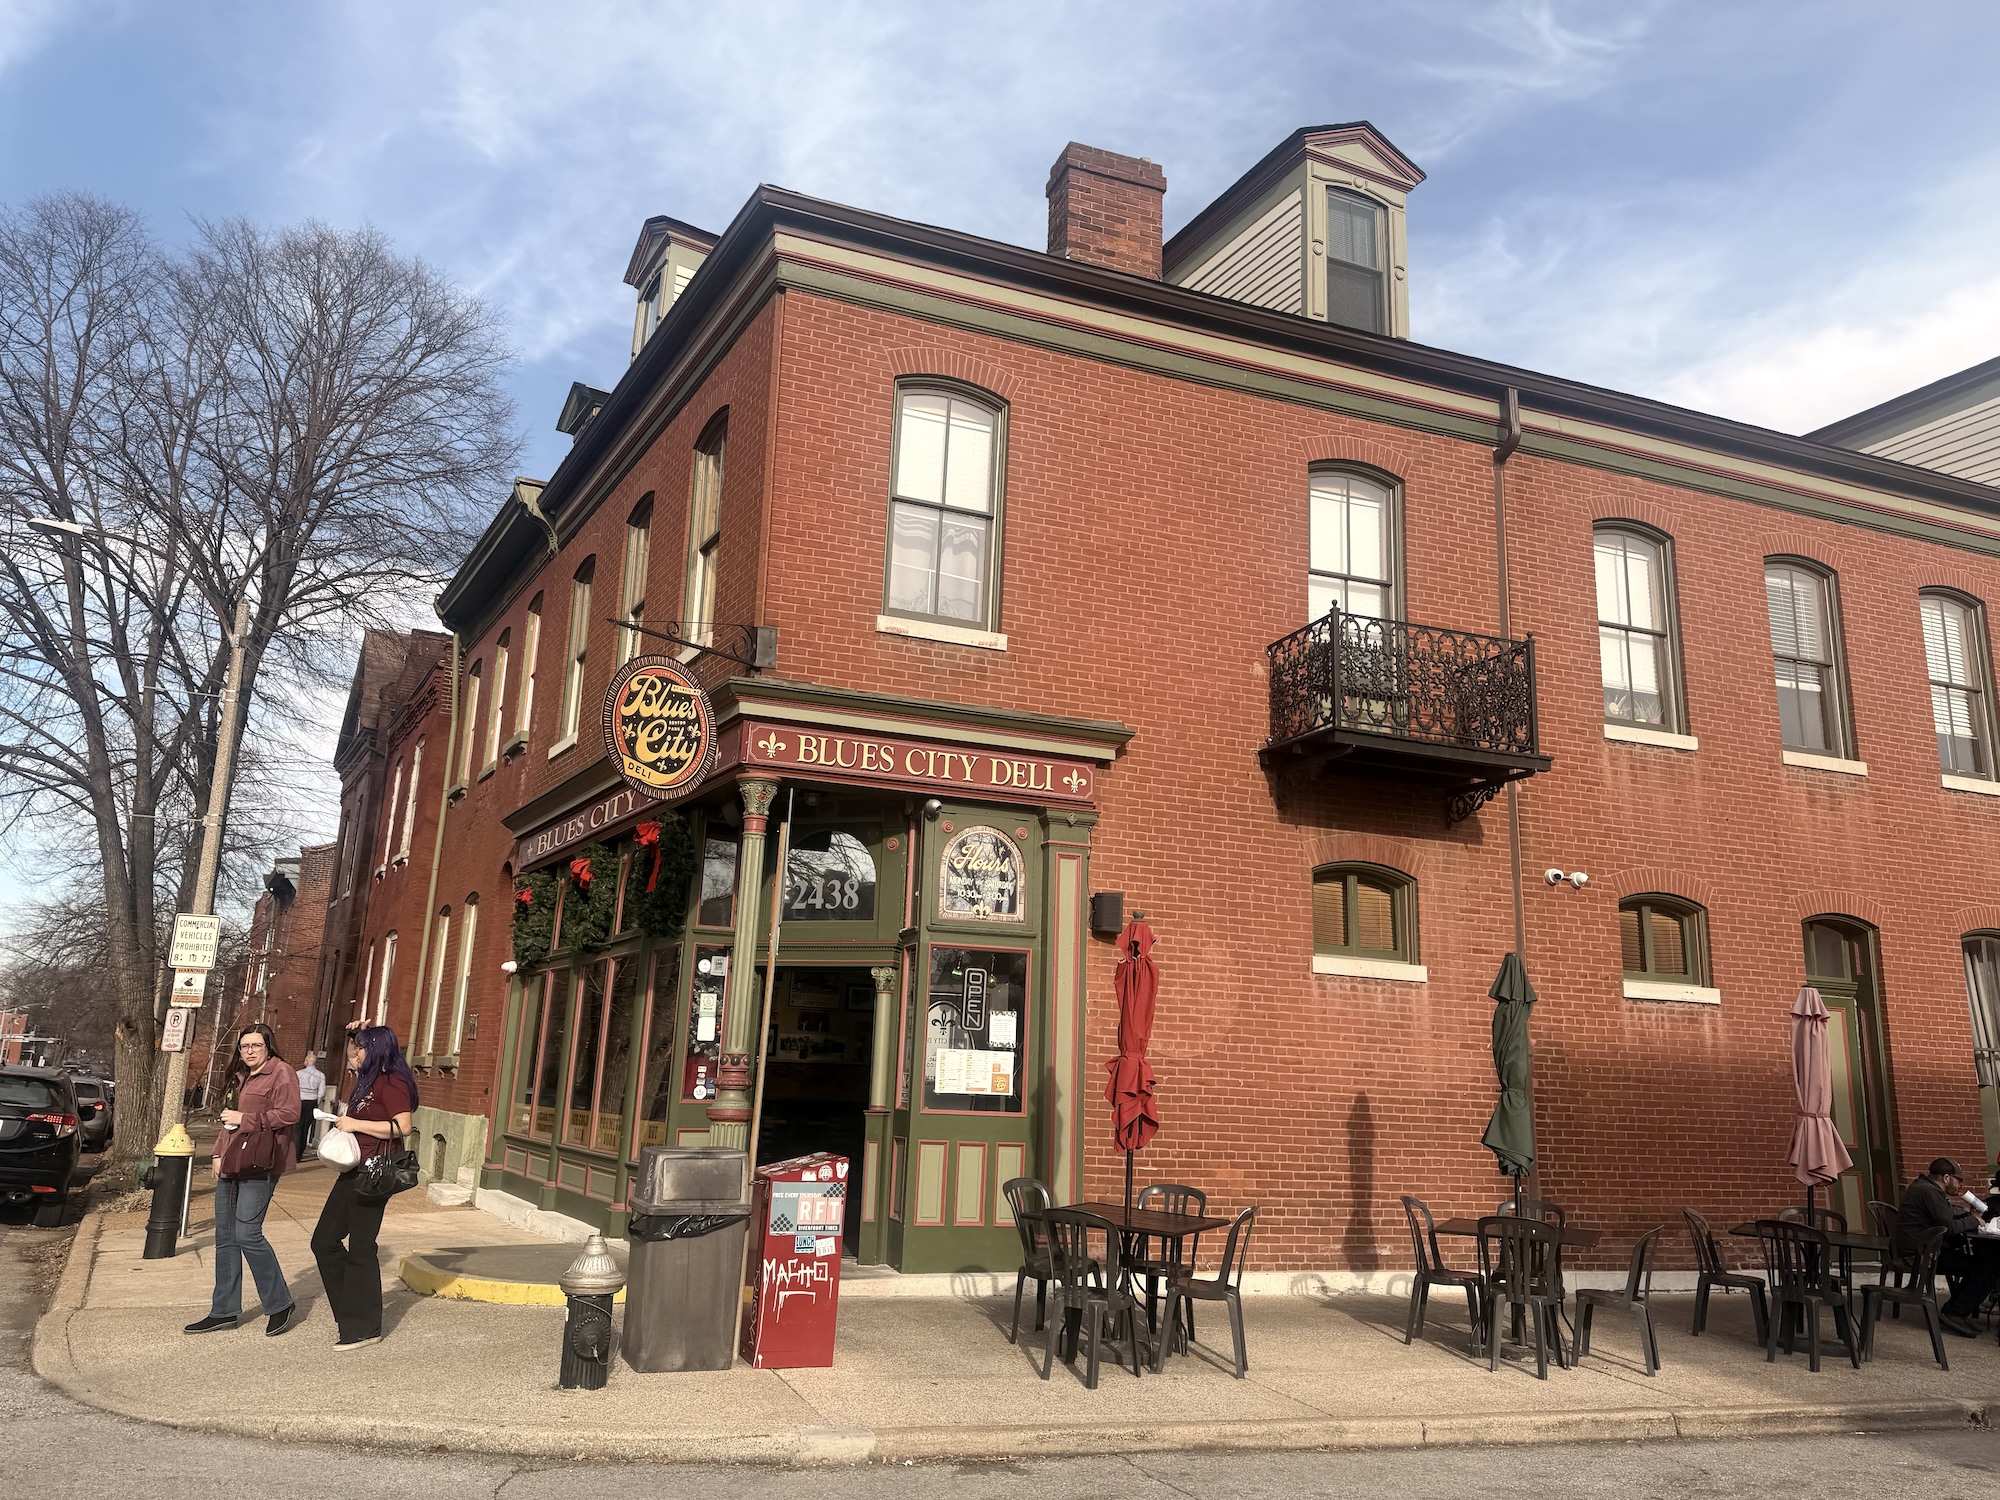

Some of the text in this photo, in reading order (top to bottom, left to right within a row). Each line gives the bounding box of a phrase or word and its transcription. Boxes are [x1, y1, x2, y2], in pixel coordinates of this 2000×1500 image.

[620, 674, 697, 719] Blues
[635, 718, 698, 762] City
[627, 762, 652, 779] DELI
[796, 734, 1054, 792] BLUES CITY DELI
[536, 789, 637, 856] BLUES CITY
[953, 845, 1009, 872] Hours
[791, 879, 859, 910] 2438
[949, 875, 1013, 890] MONDAY SATURDAY
[179, 919, 216, 929] COMMERCIAL
[180, 930, 213, 940] VEHICLES
[175, 942, 214, 951] PROHIBITED
[966, 972, 983, 1027] OPEN
[800, 1200, 840, 1221] RFT
[796, 1236, 815, 1247] LUNCH
